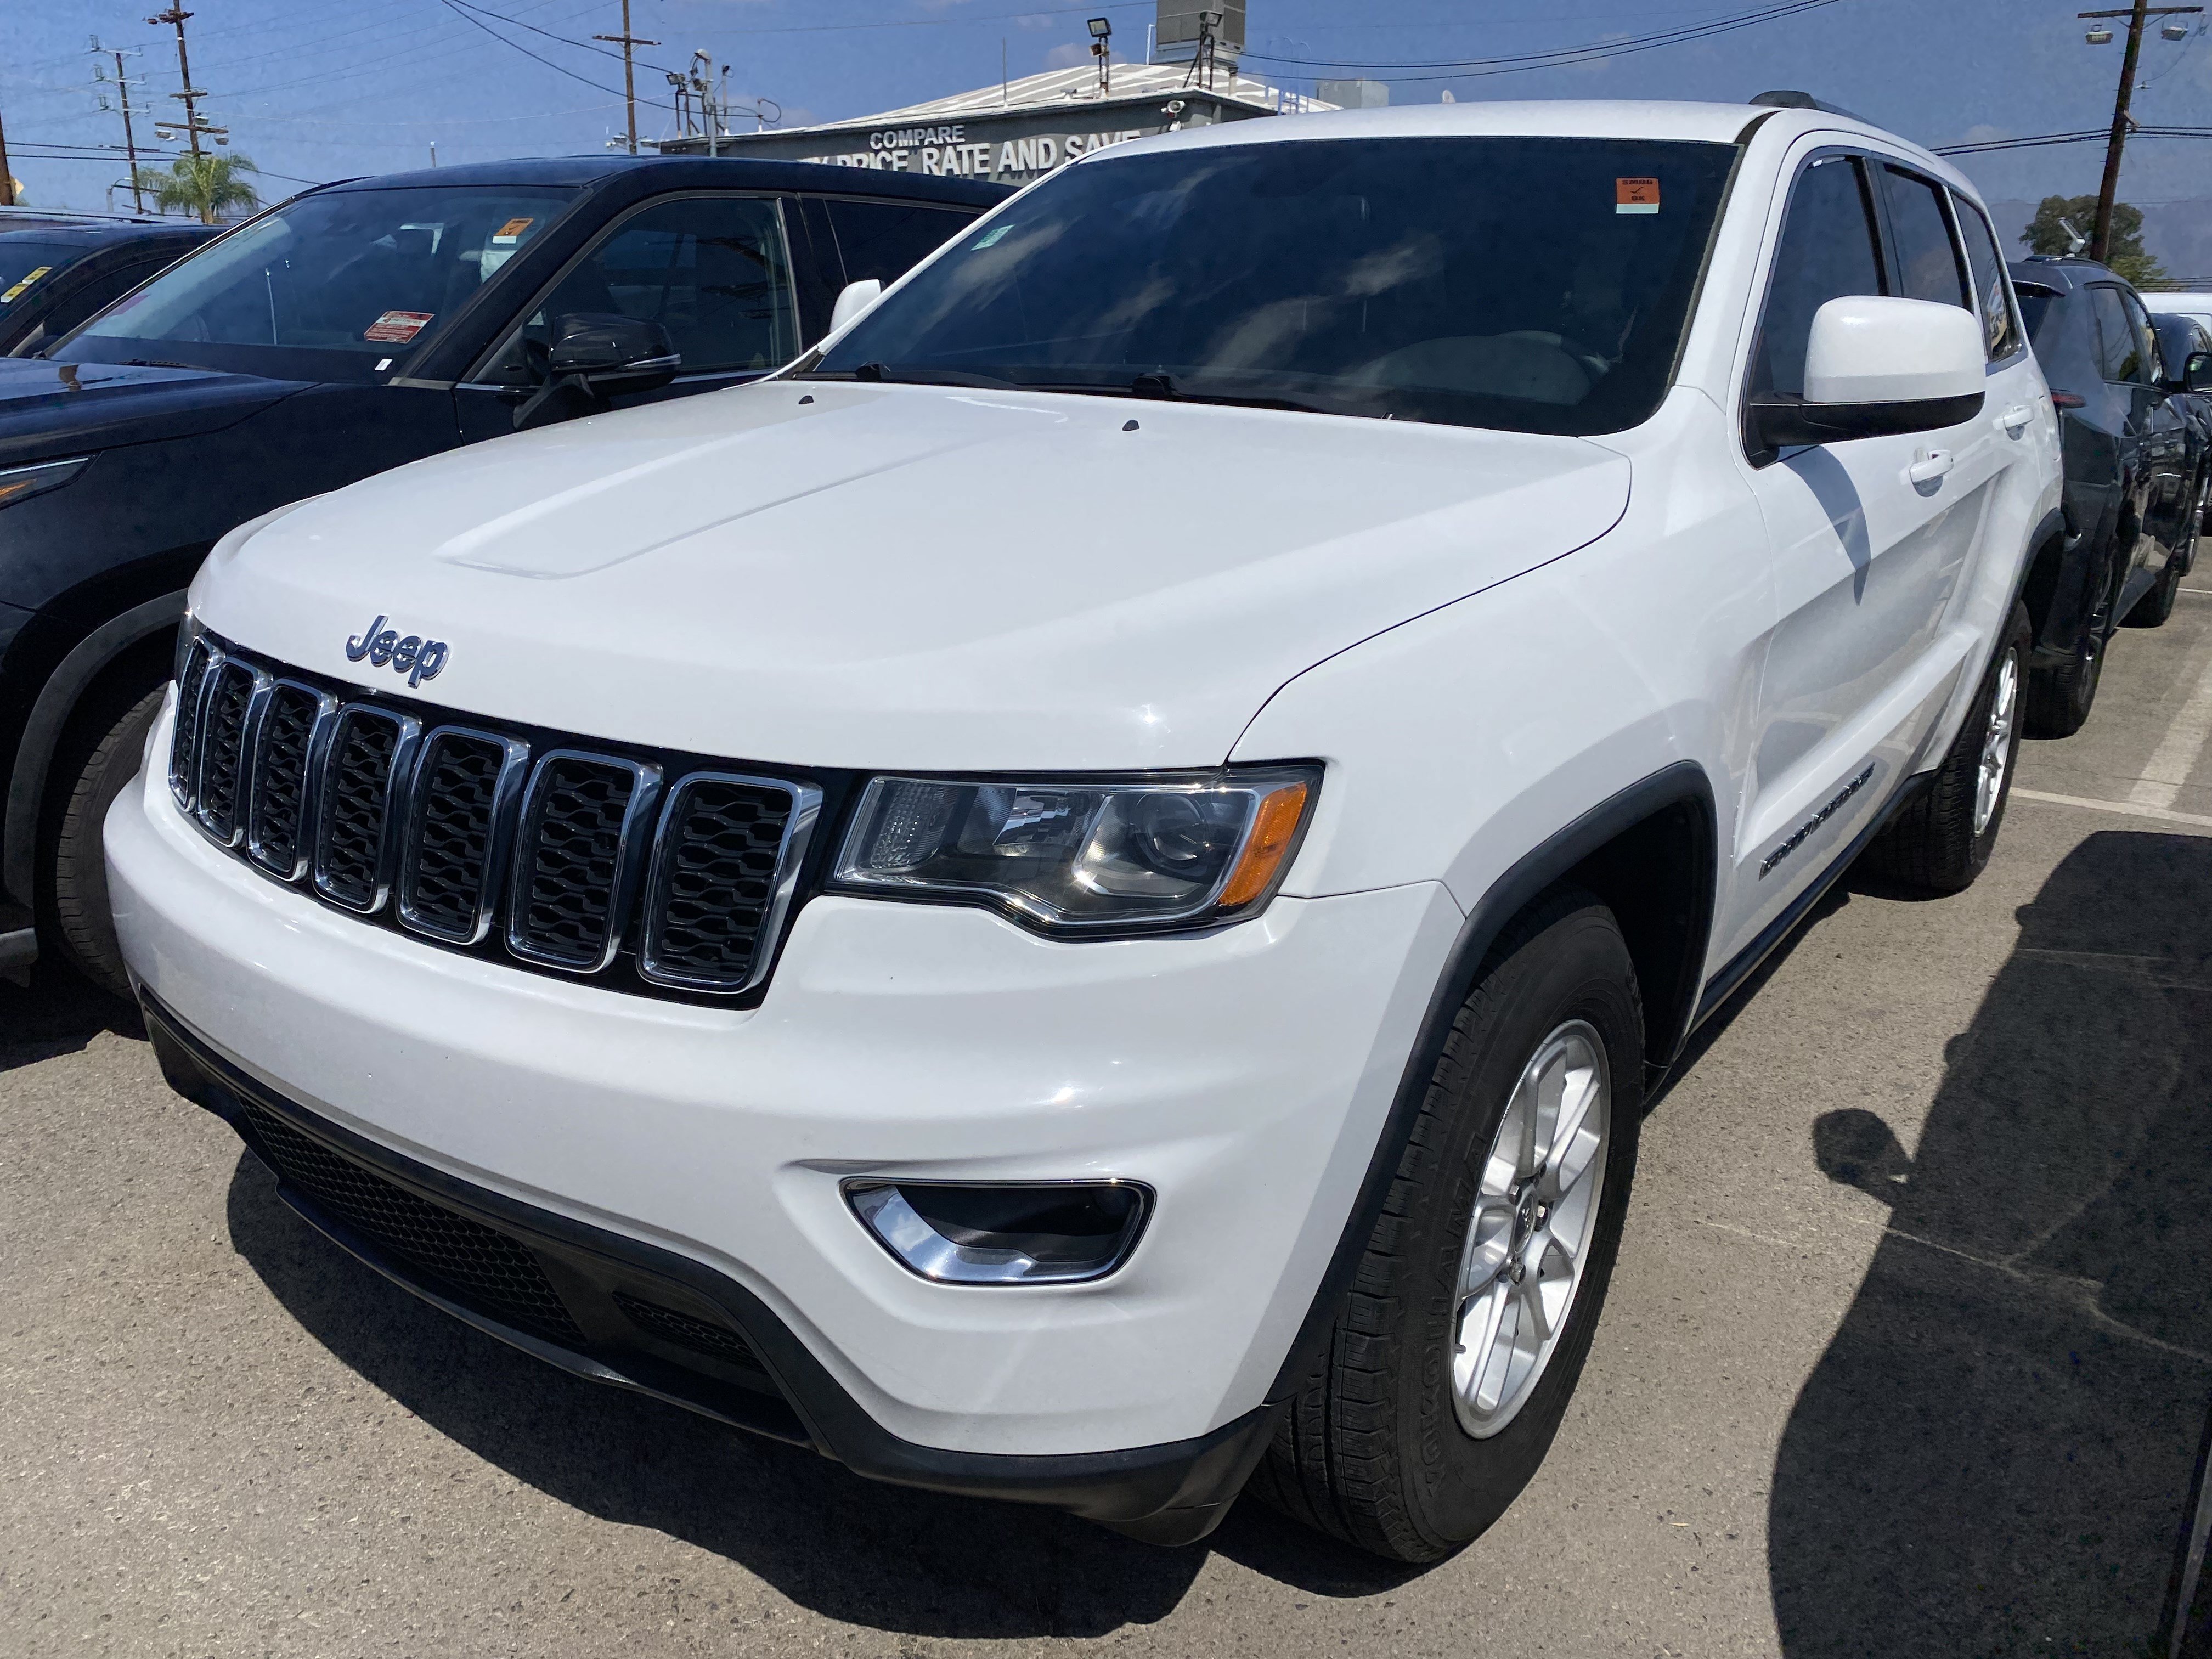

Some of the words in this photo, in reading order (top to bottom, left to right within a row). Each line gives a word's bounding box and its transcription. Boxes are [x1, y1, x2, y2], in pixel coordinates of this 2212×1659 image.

[870, 125, 966, 150] COMPARE
[922, 143, 991, 176] RATE
[997, 138, 1057, 172] AND
[346, 614, 450, 689] Jeep
[1421, 1132, 1488, 1498] YOKOHAMA
